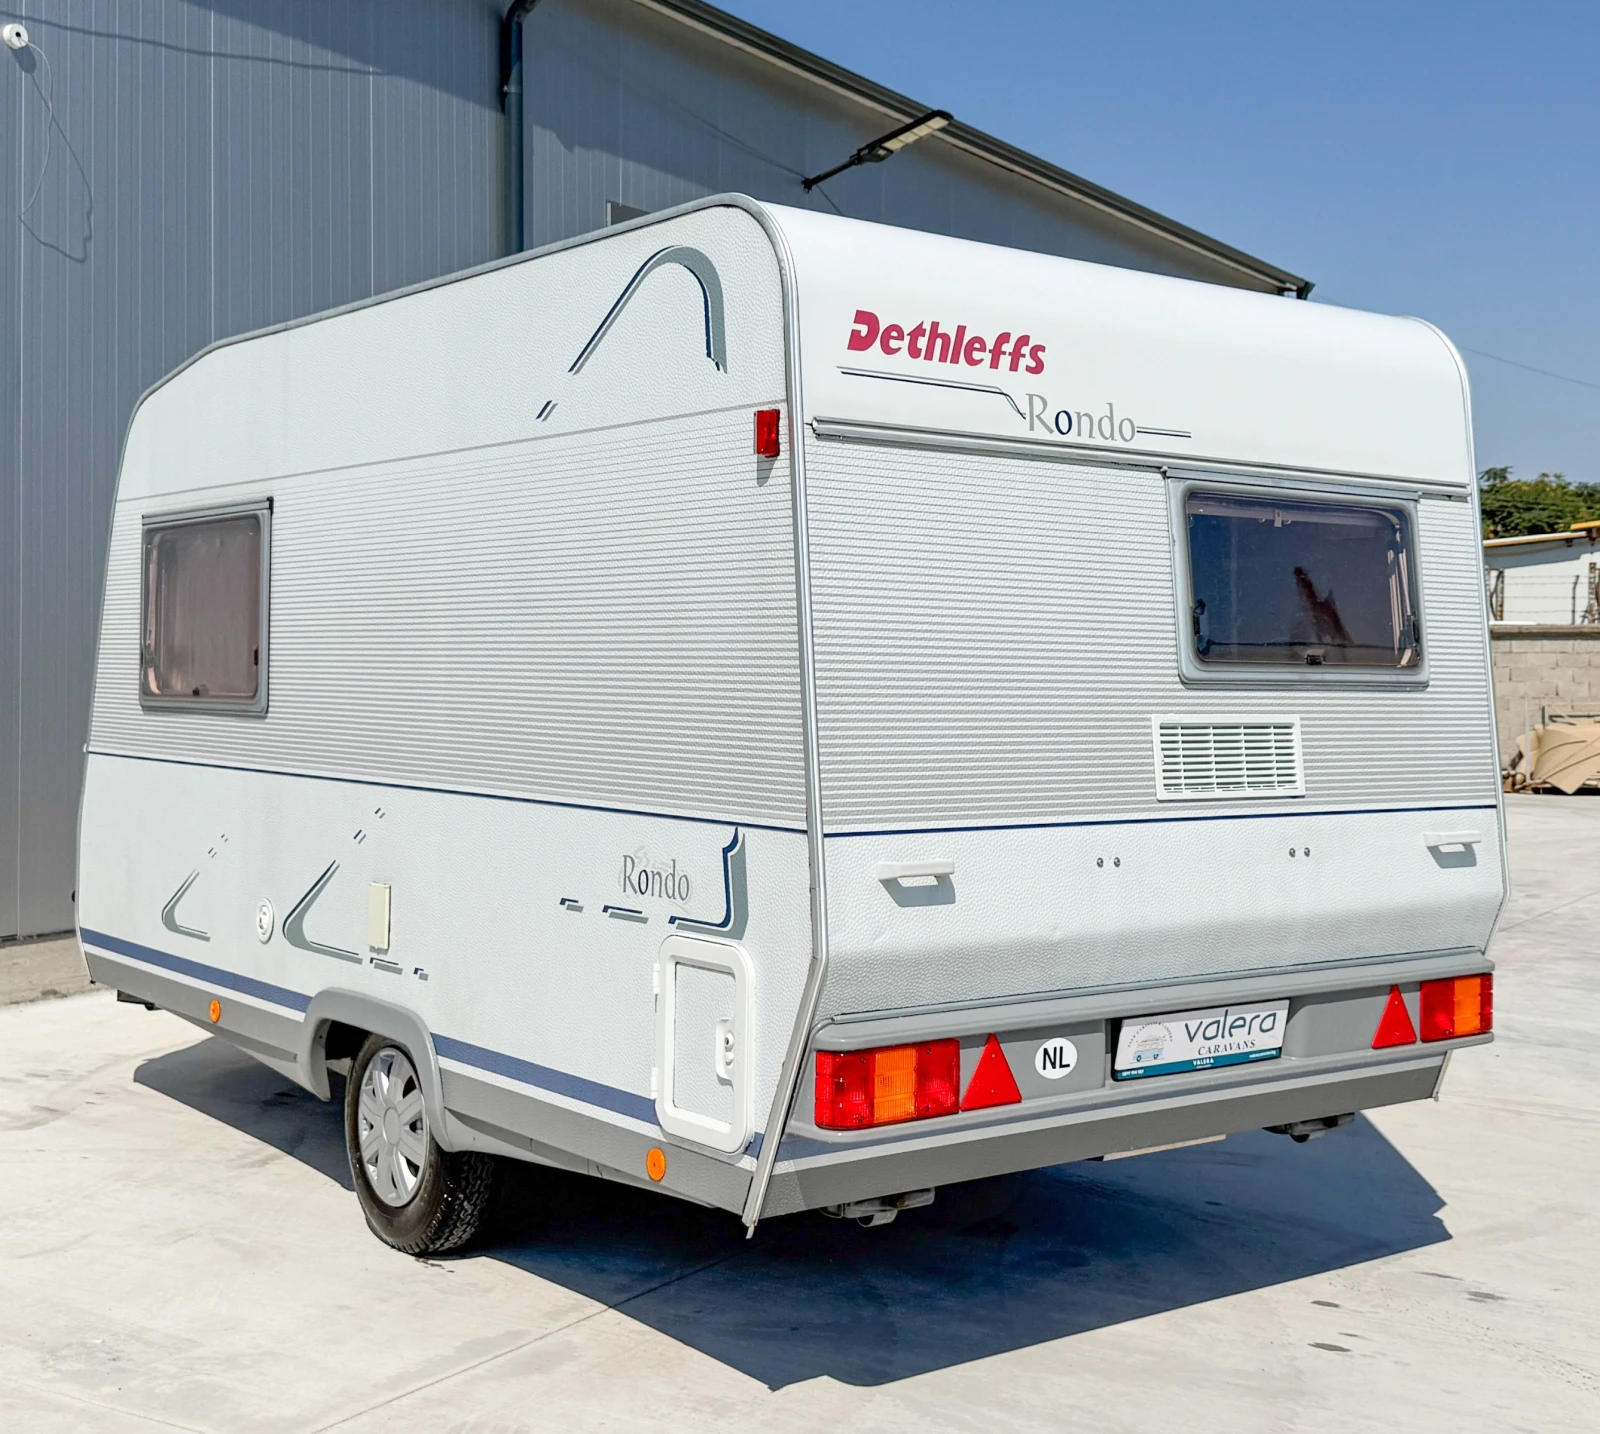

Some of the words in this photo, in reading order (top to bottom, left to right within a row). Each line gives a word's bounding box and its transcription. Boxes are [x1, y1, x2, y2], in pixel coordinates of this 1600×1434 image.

[847, 309, 1046, 375] Dethleffs
[1025, 393, 1136, 442] Rondo
[622, 854, 690, 901] Rondo
[1184, 1009, 1277, 1042] valera
[1042, 1046, 1071, 1071] NL
[1197, 1039, 1256, 1056] CARAVANS
